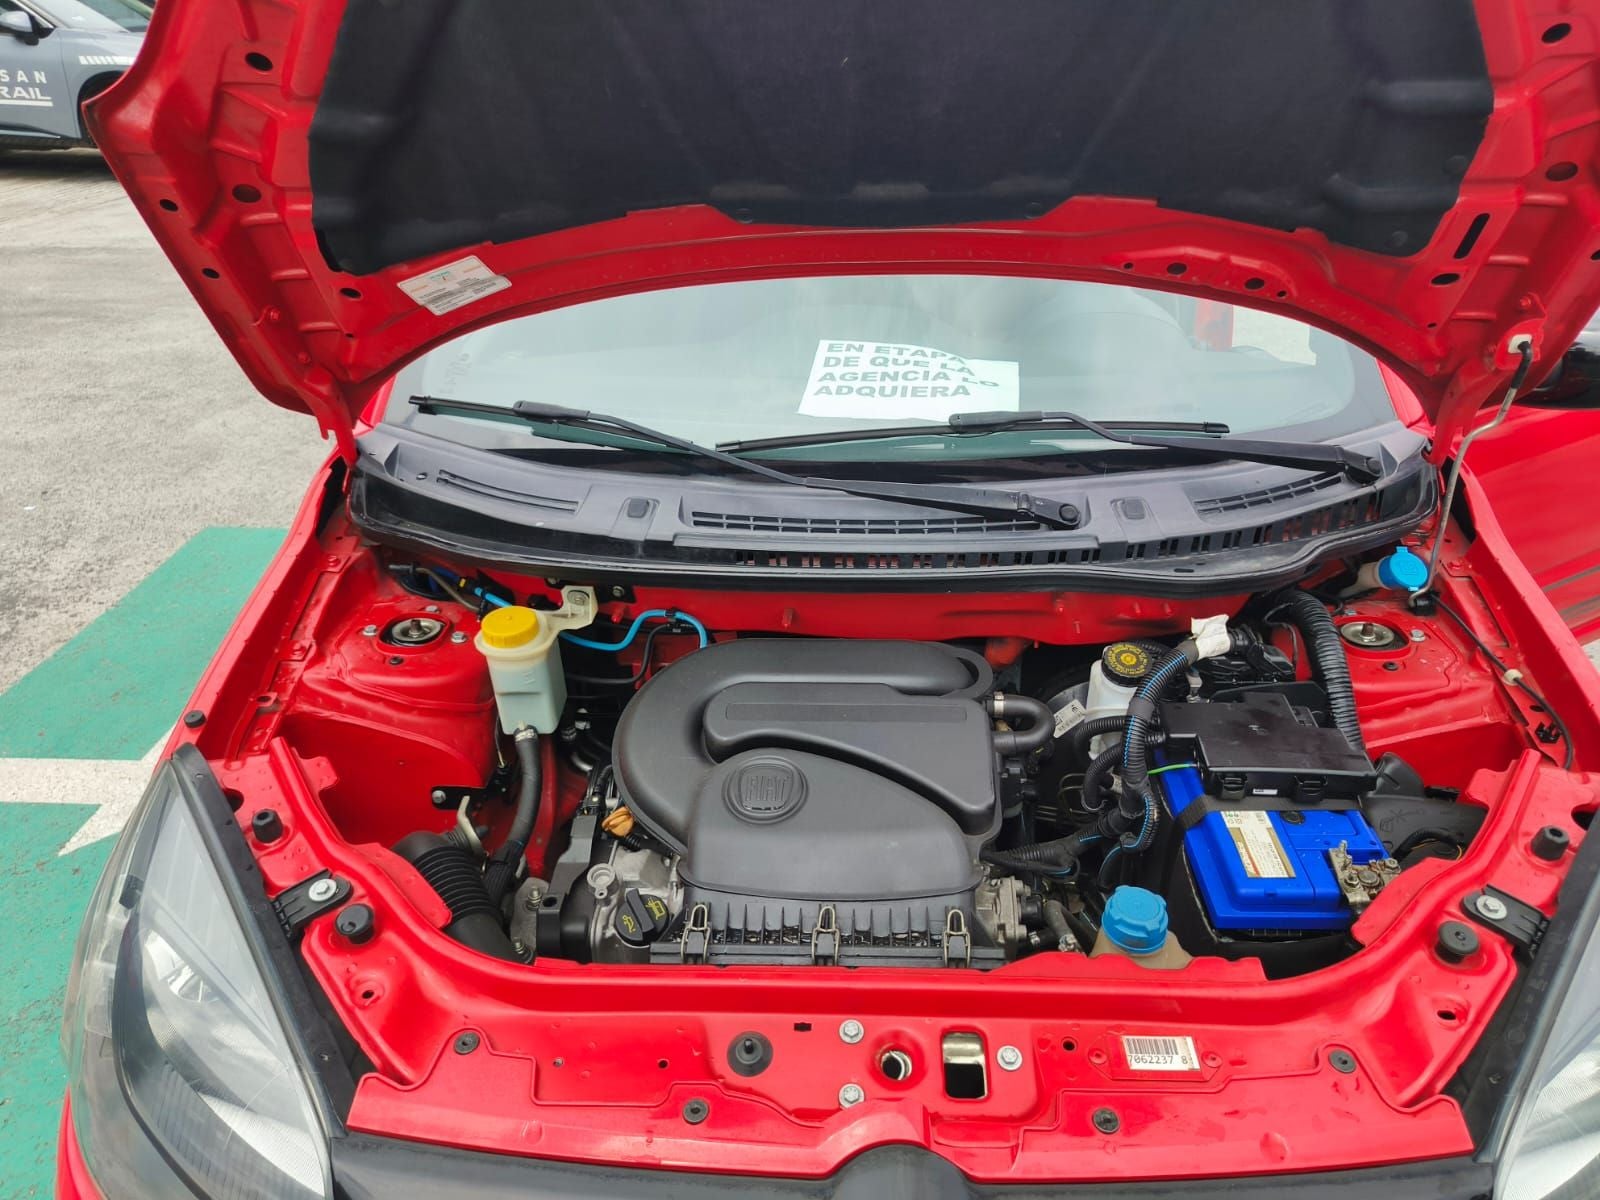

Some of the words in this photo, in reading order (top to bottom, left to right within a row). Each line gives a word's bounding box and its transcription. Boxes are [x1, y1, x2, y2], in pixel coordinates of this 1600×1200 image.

[827, 343, 864, 353] EN
[874, 345, 967, 365] ETAPA
[823, 356, 860, 368] DE
[869, 356, 930, 369] QUE
[940, 362, 976, 377] LA
[817, 370, 951, 382] AGENCIA
[961, 377, 1000, 388] LO
[813, 385, 971, 399] ADQUIERA
